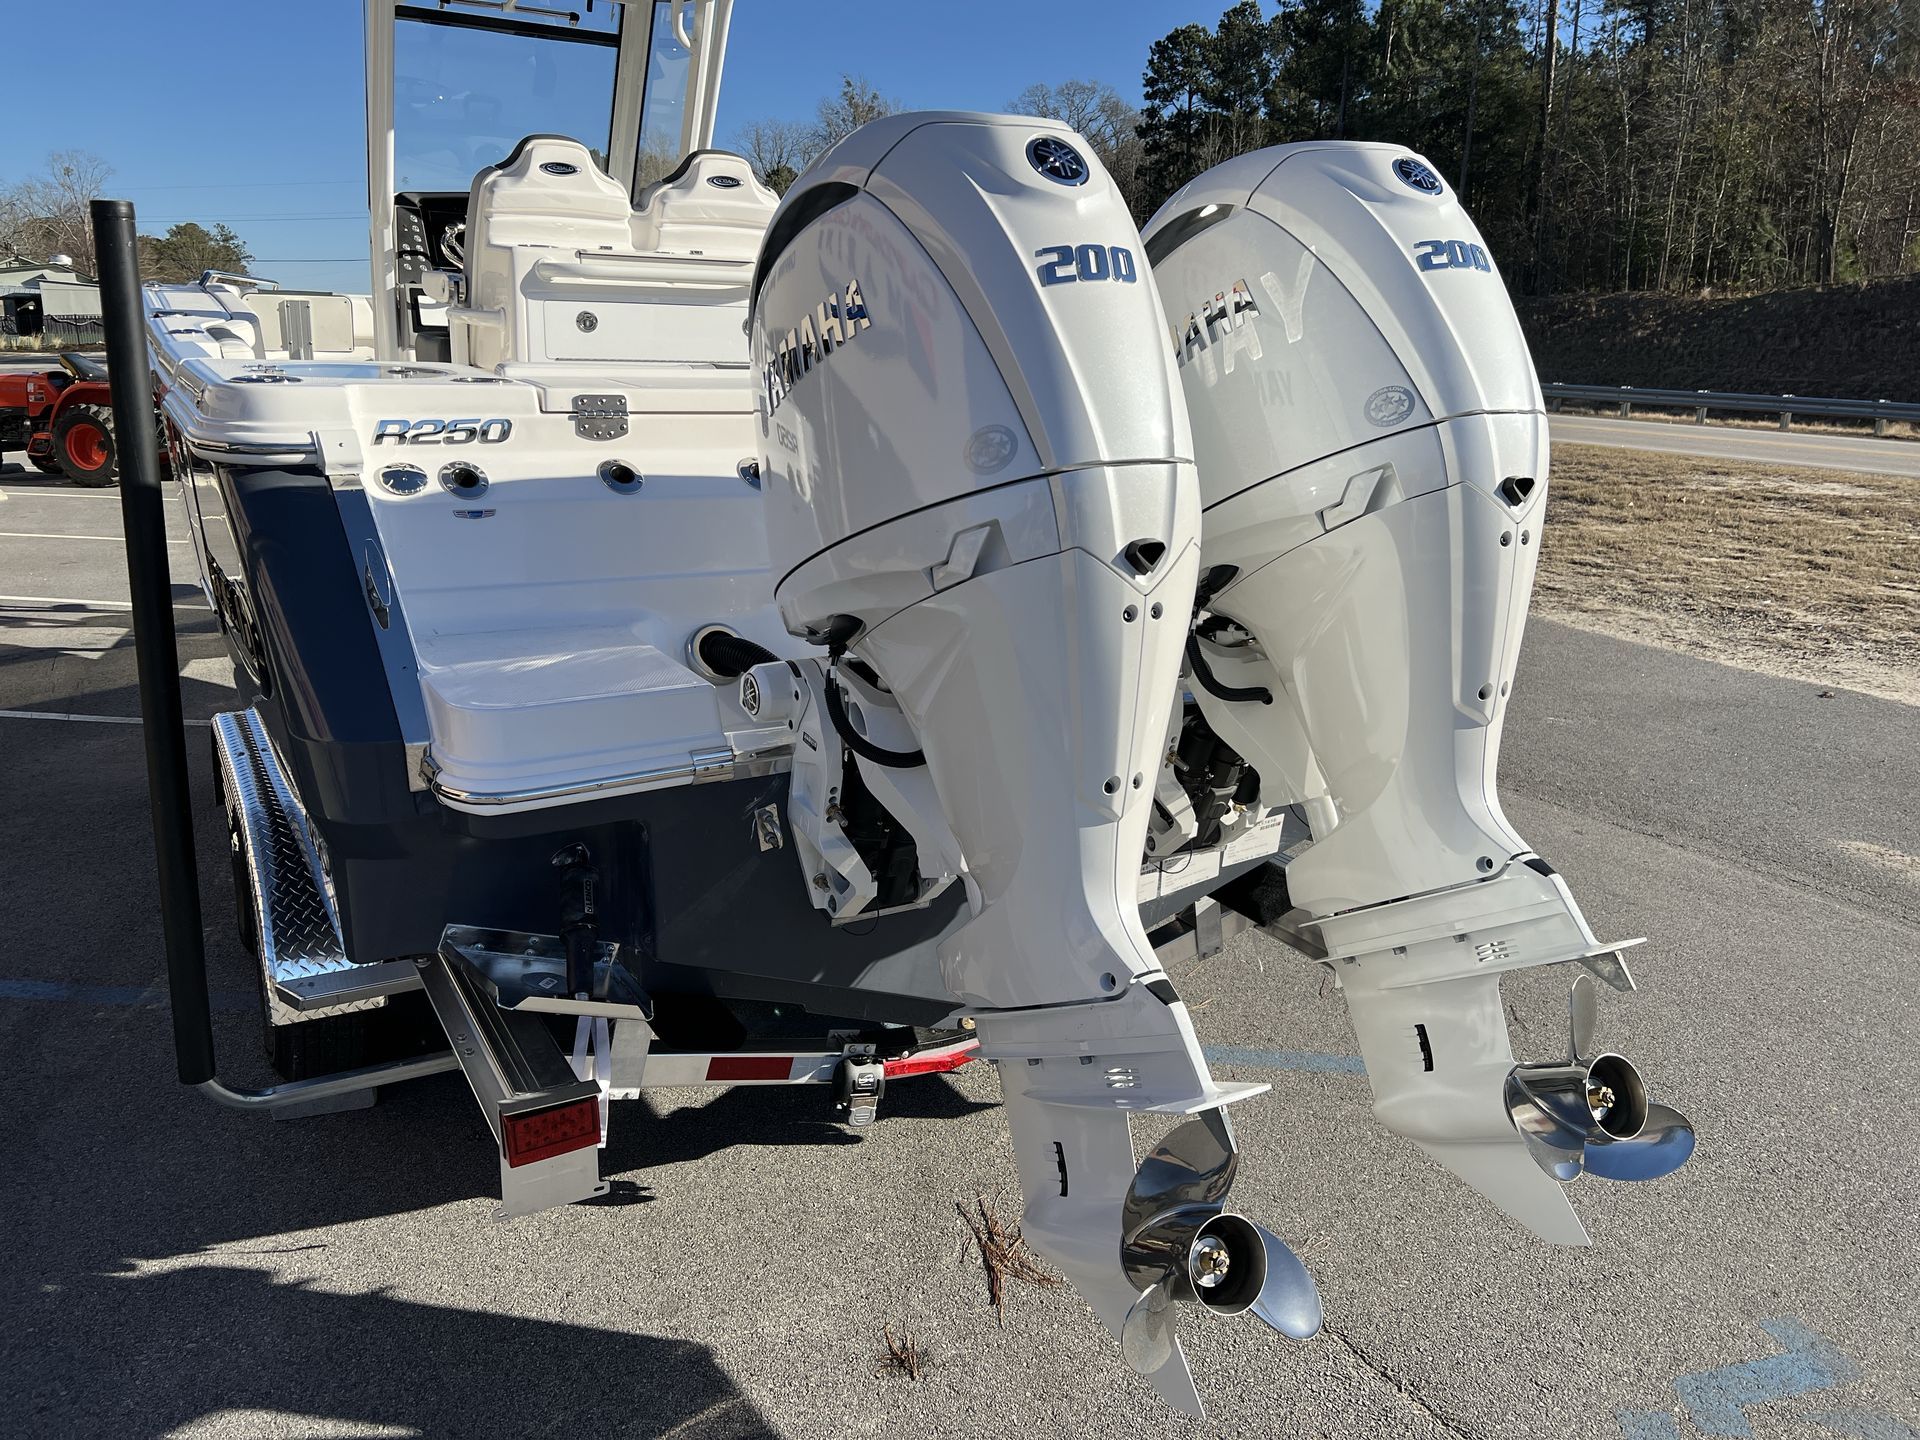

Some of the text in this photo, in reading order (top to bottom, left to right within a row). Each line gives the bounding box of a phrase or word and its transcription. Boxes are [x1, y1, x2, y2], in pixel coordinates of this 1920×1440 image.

[1035, 244, 1137, 287] 200
[1413, 240, 1491, 273] 200
[763, 280, 871, 417] YAMAHA
[371, 418, 512, 446] R250
